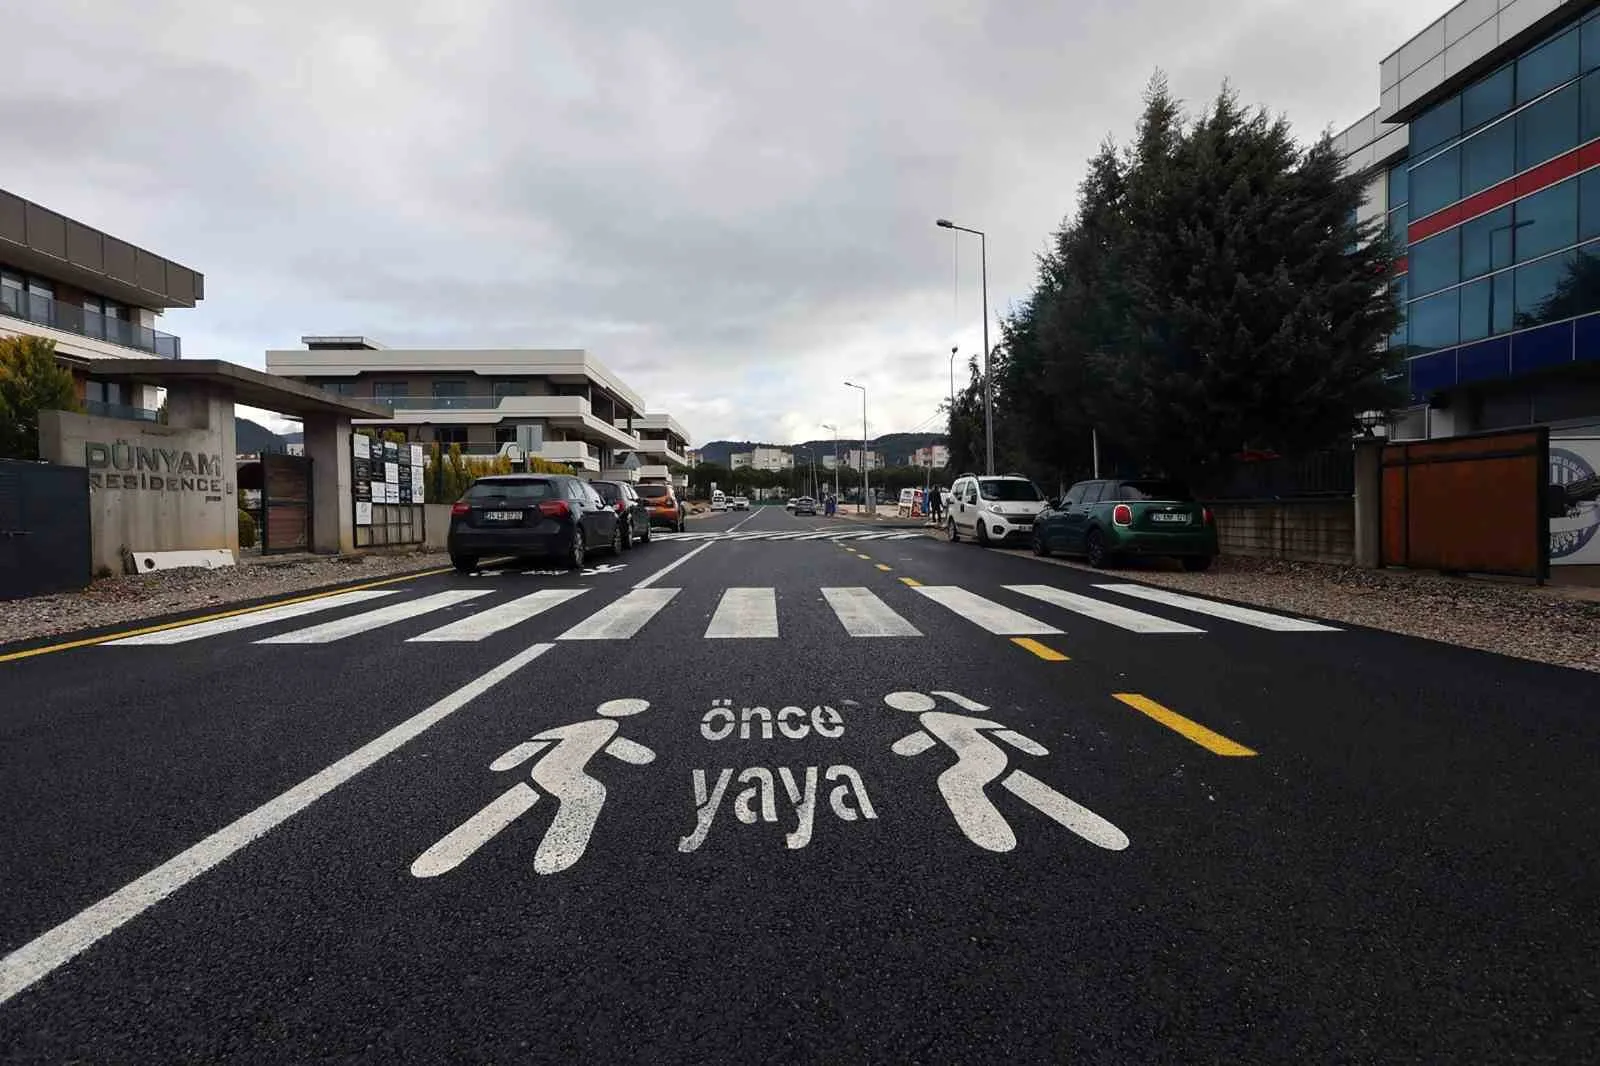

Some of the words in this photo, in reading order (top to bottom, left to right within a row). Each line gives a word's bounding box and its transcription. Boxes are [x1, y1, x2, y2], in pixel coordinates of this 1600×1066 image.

[85, 439, 221, 476] DÜNYAM
[700, 699, 845, 741] önce
[678, 764, 878, 852] yaya
